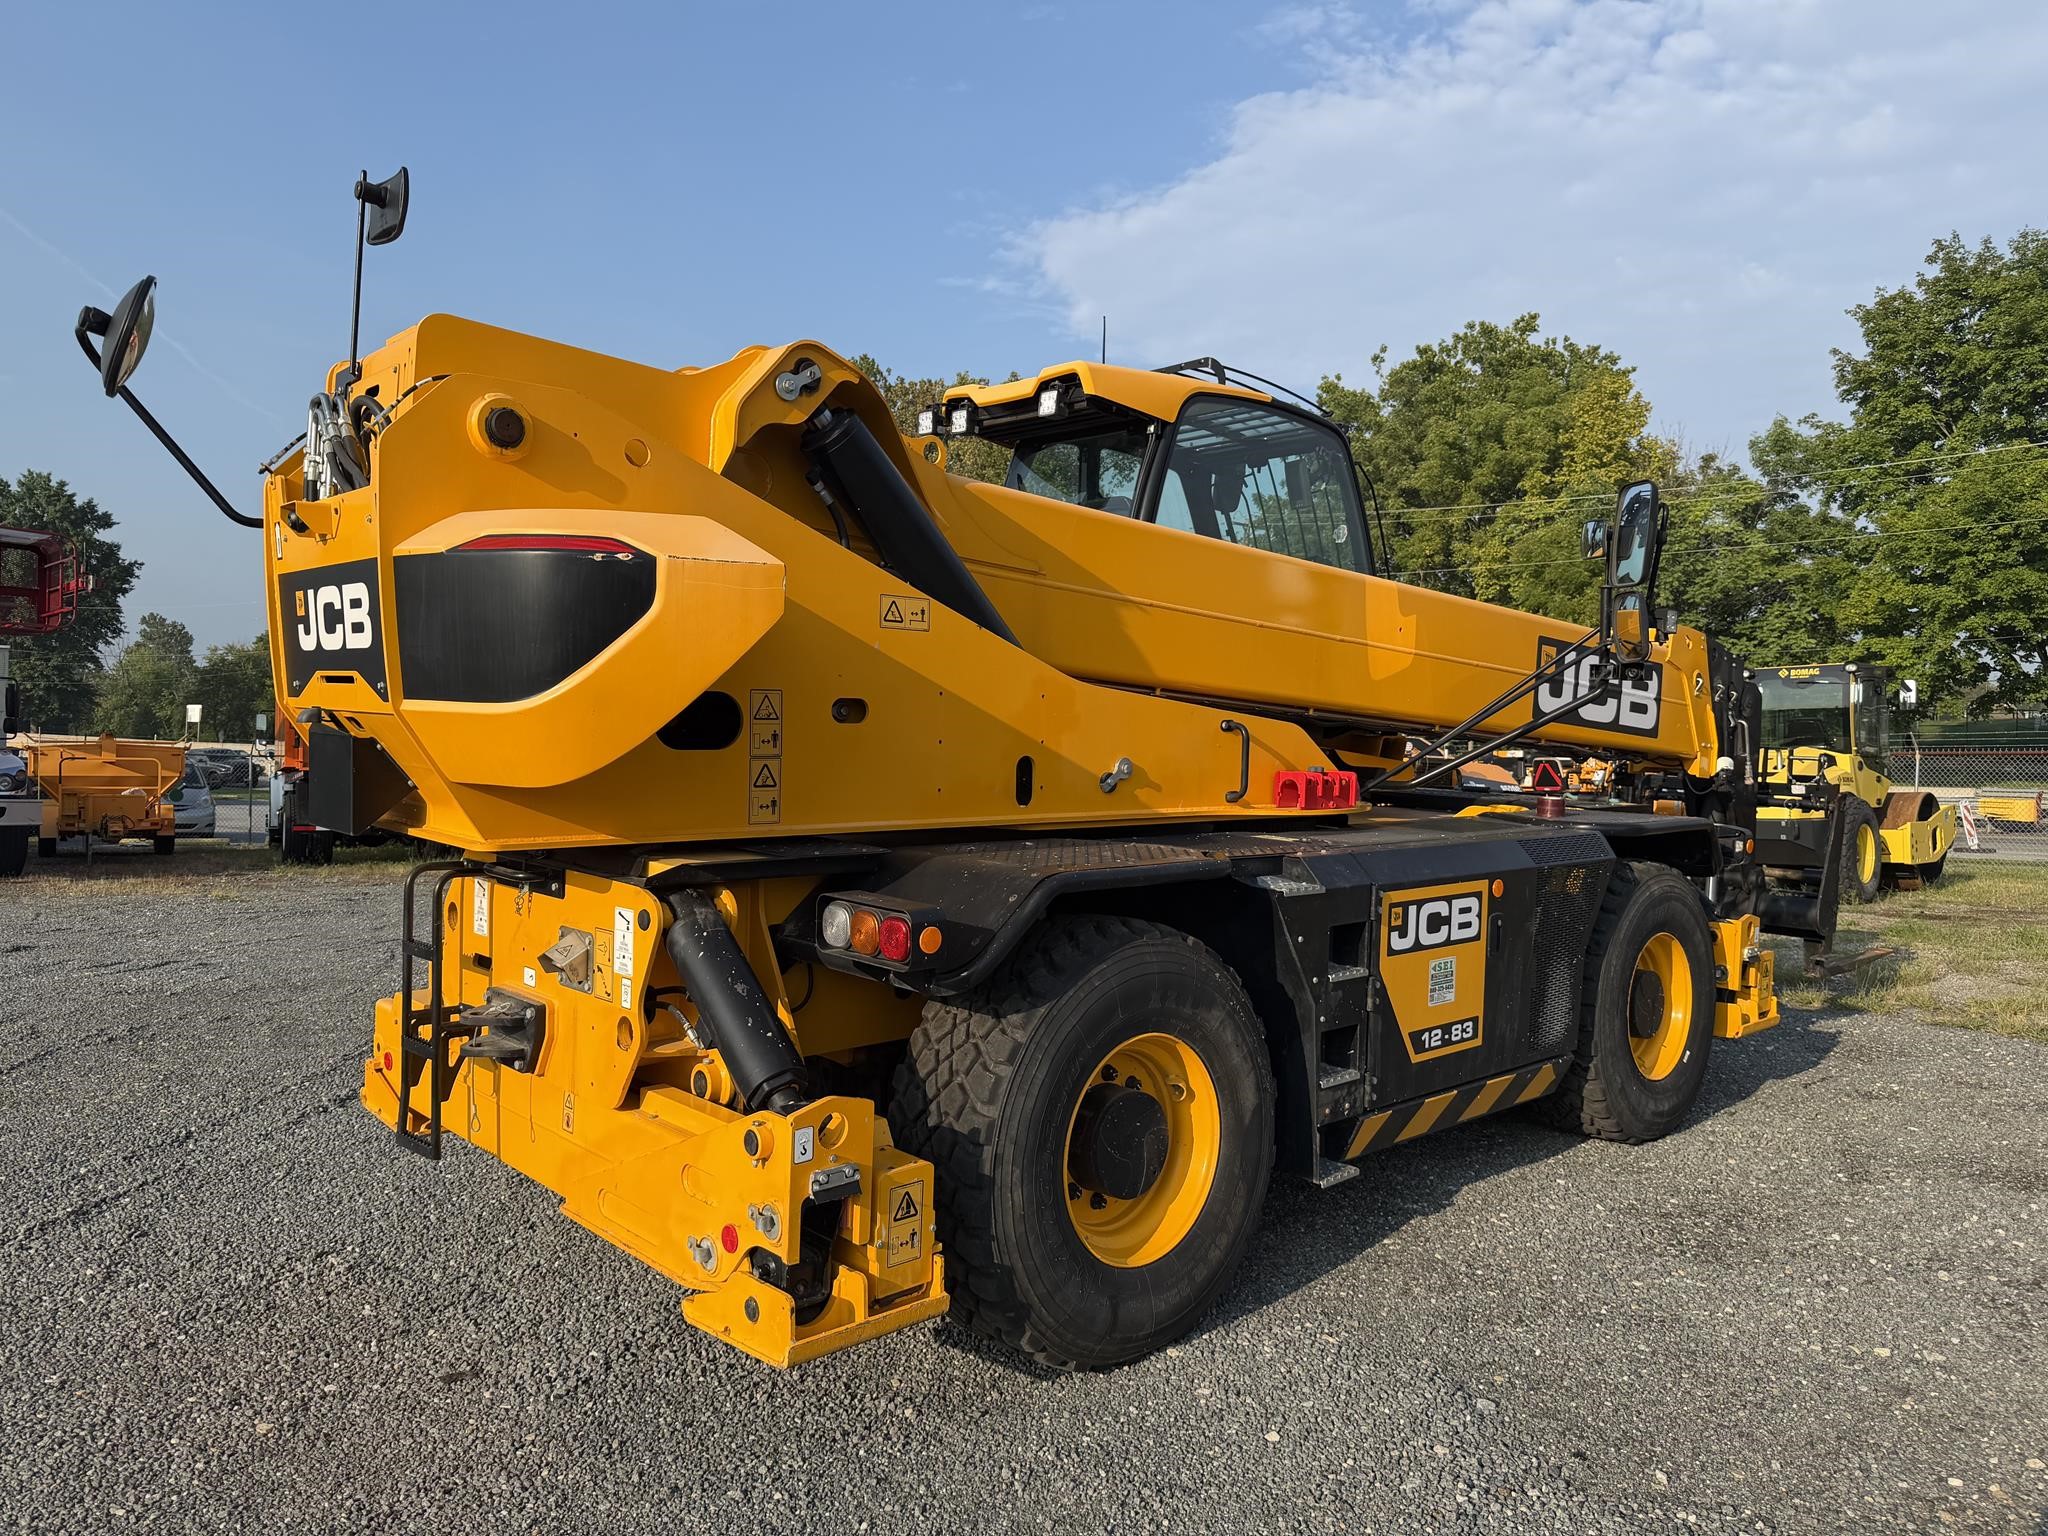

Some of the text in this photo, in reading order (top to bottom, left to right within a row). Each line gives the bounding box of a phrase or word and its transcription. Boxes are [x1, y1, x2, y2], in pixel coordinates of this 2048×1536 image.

[297, 582, 372, 651] JCB
[1790, 668, 1820, 676] BOMAG
[1390, 896, 1480, 951] JCB
[1437, 960, 1454, 972] SEI
